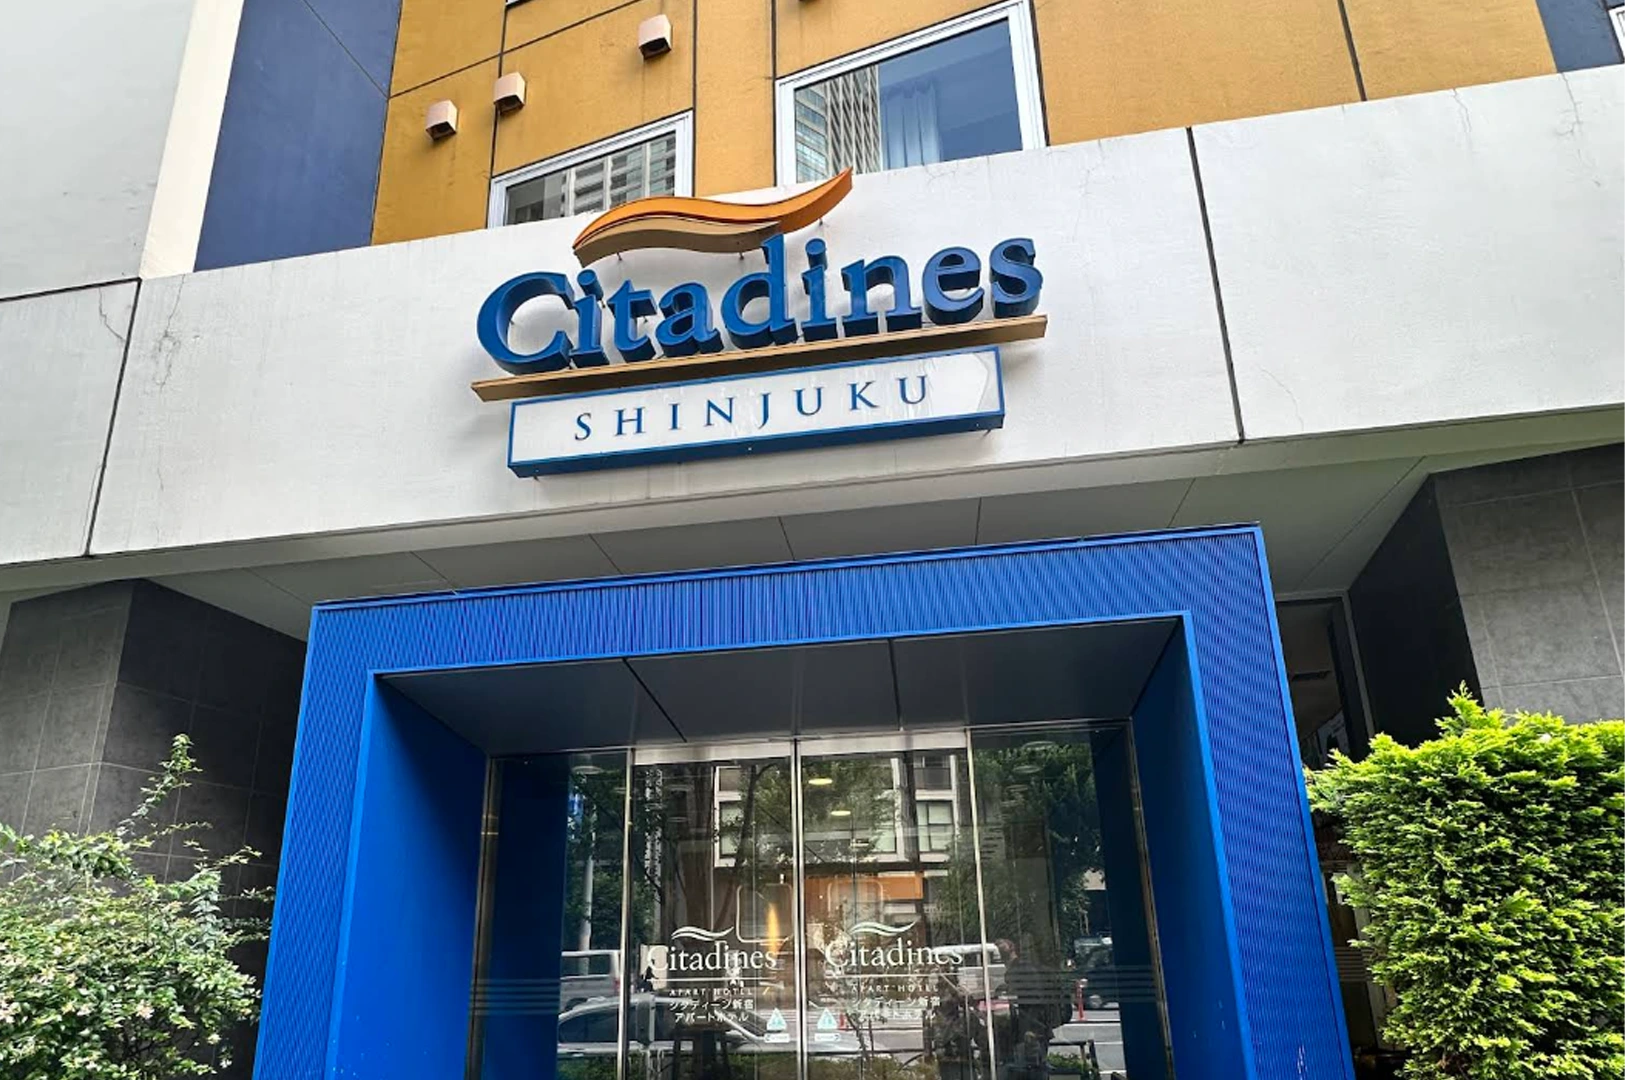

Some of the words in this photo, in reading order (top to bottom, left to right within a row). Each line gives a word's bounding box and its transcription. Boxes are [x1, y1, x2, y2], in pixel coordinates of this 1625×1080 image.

[477, 233, 1042, 374] Citadines
[575, 375, 927, 440] SHINJUKU
[647, 940, 777, 971] Citadines
[825, 938, 963, 967] Citadines
